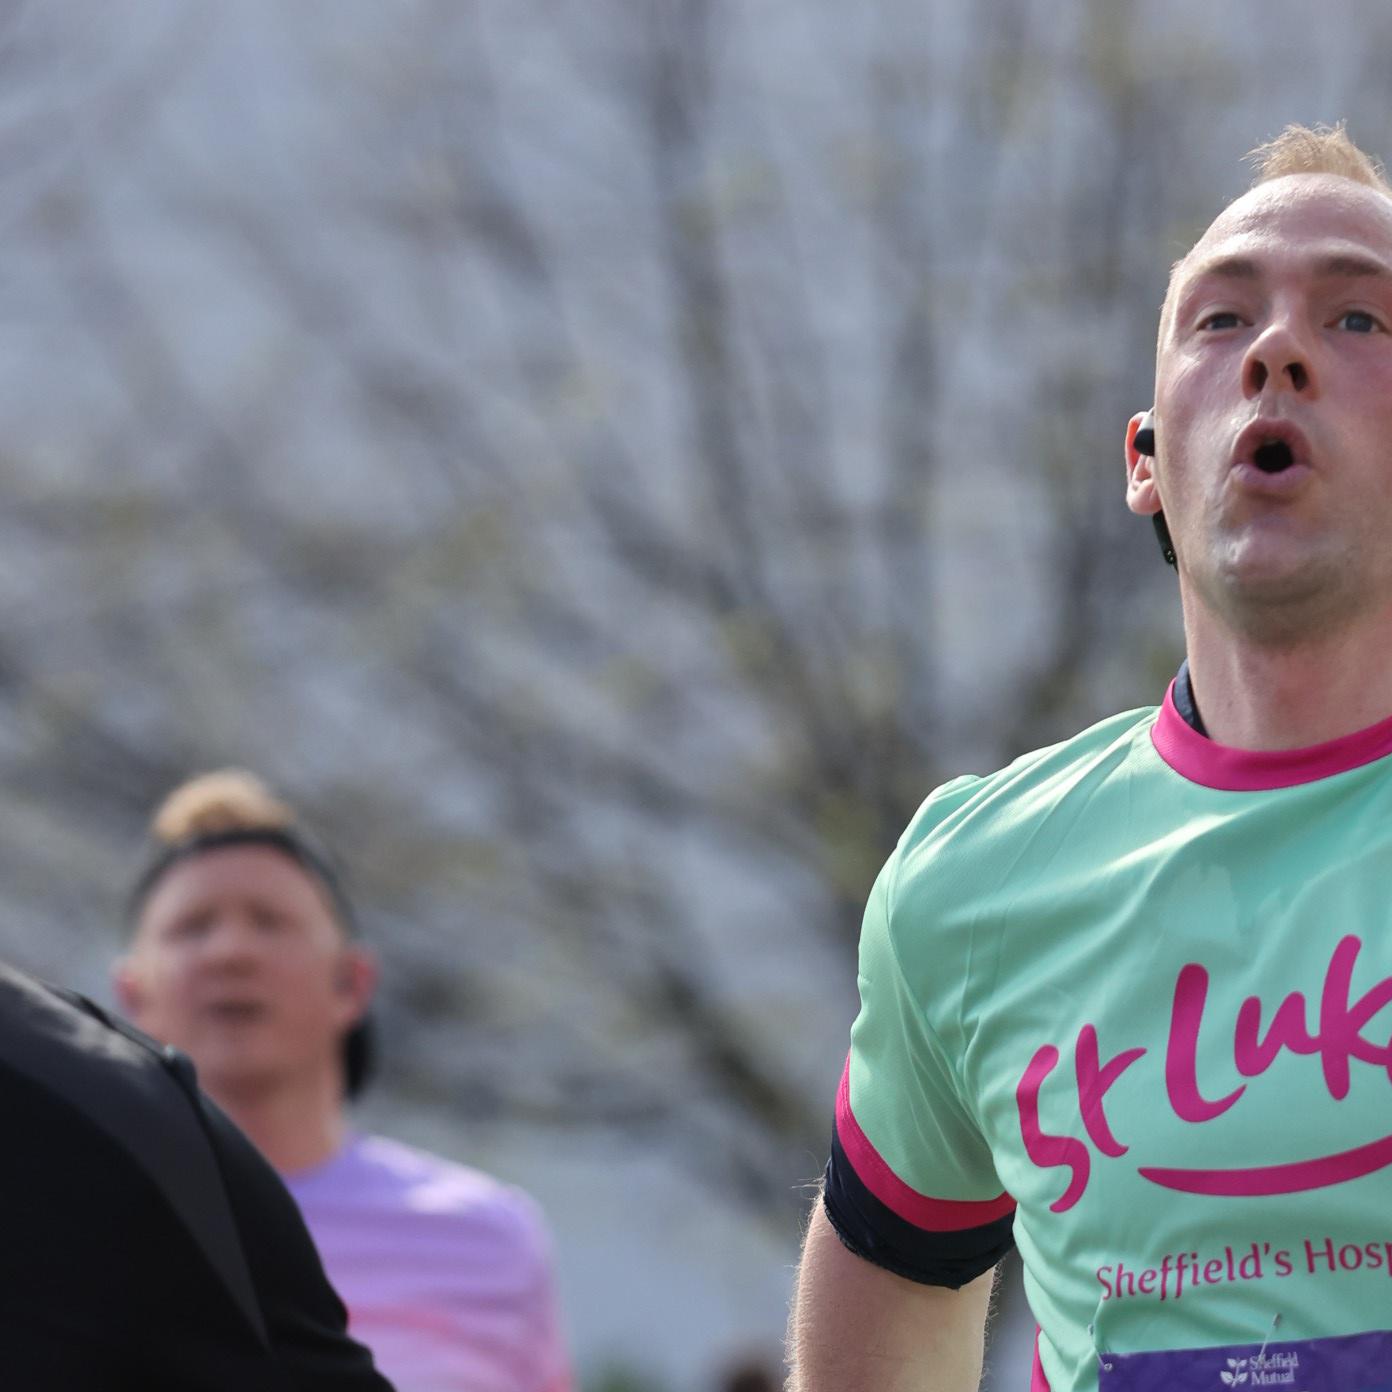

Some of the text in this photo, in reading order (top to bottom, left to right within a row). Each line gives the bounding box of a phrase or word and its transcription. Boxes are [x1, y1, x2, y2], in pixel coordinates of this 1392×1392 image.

[1016, 1024, 1147, 1213] St
[1096, 1243, 1294, 1302] Sheffield's
[1250, 1367, 1296, 1386] Mutual
